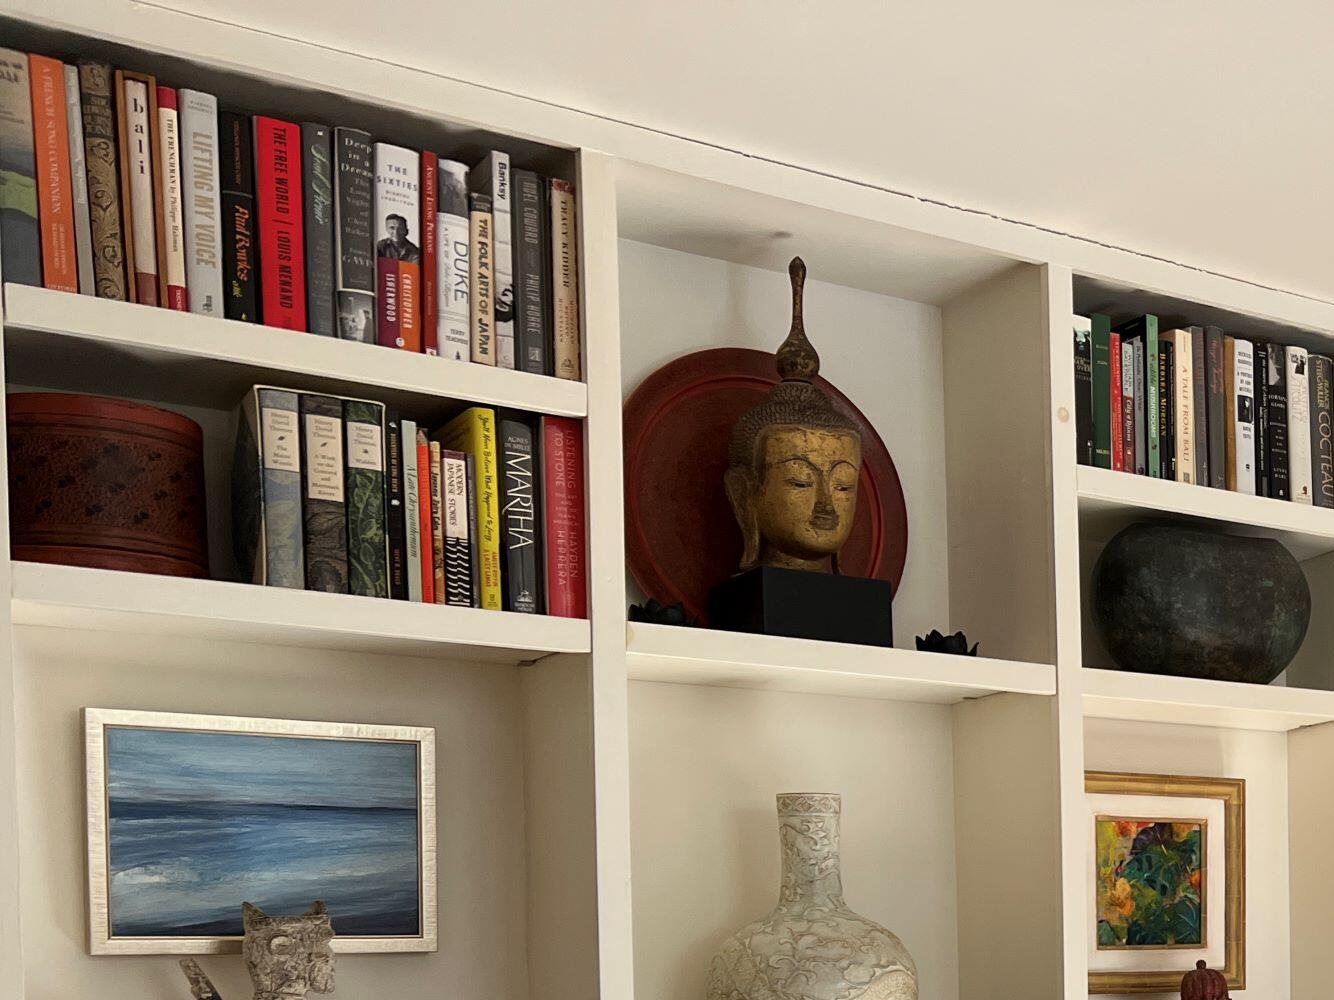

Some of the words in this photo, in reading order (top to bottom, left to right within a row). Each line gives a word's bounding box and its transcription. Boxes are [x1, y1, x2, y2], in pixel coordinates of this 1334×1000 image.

[273, 127, 287, 146] THE
[345, 138, 372, 154] Deep
[192, 131, 213, 191] LIFTING
[274, 149, 288, 175] FREE
[387, 165, 408, 177] THE
[275, 179, 290, 214] WORLD
[376, 175, 418, 192] SIXTIES
[497, 162, 507, 200] Banksy
[194, 195, 214, 221] MY
[561, 200, 569, 237] TRACY
[478, 219, 489, 239] THE
[195, 224, 216, 269] VOICE
[277, 231, 291, 261] LOUIS
[477, 241, 488, 270] FOLK
[454, 240, 469, 304] DUKE
[562, 242, 570, 288] KIDDER
[279, 265, 293, 309] MENAND
[386, 273, 396, 322] ISHERWOOD
[403, 273, 413, 329] CHRISTOPHER
[478, 273, 489, 298] ARTS
[479, 300, 488, 315] OF
[479, 318, 489, 355] JAPAN
[507, 436, 529, 445] AGNES
[554, 432, 564, 447] TO
[1318, 412, 1334, 497] COCTEAU
[483, 451, 492, 473] Believe
[554, 450, 565, 487] STONE
[566, 430, 576, 489] LISTENING
[447, 462, 456, 495] JAPANESE
[484, 475, 493, 490] What
[448, 498, 457, 526] STORIES
[483, 491, 493, 518] Happened
[501, 451, 534, 550] MARTHA
[557, 530, 567, 586] HERRERA
[569, 531, 578, 578] HAYDEN
